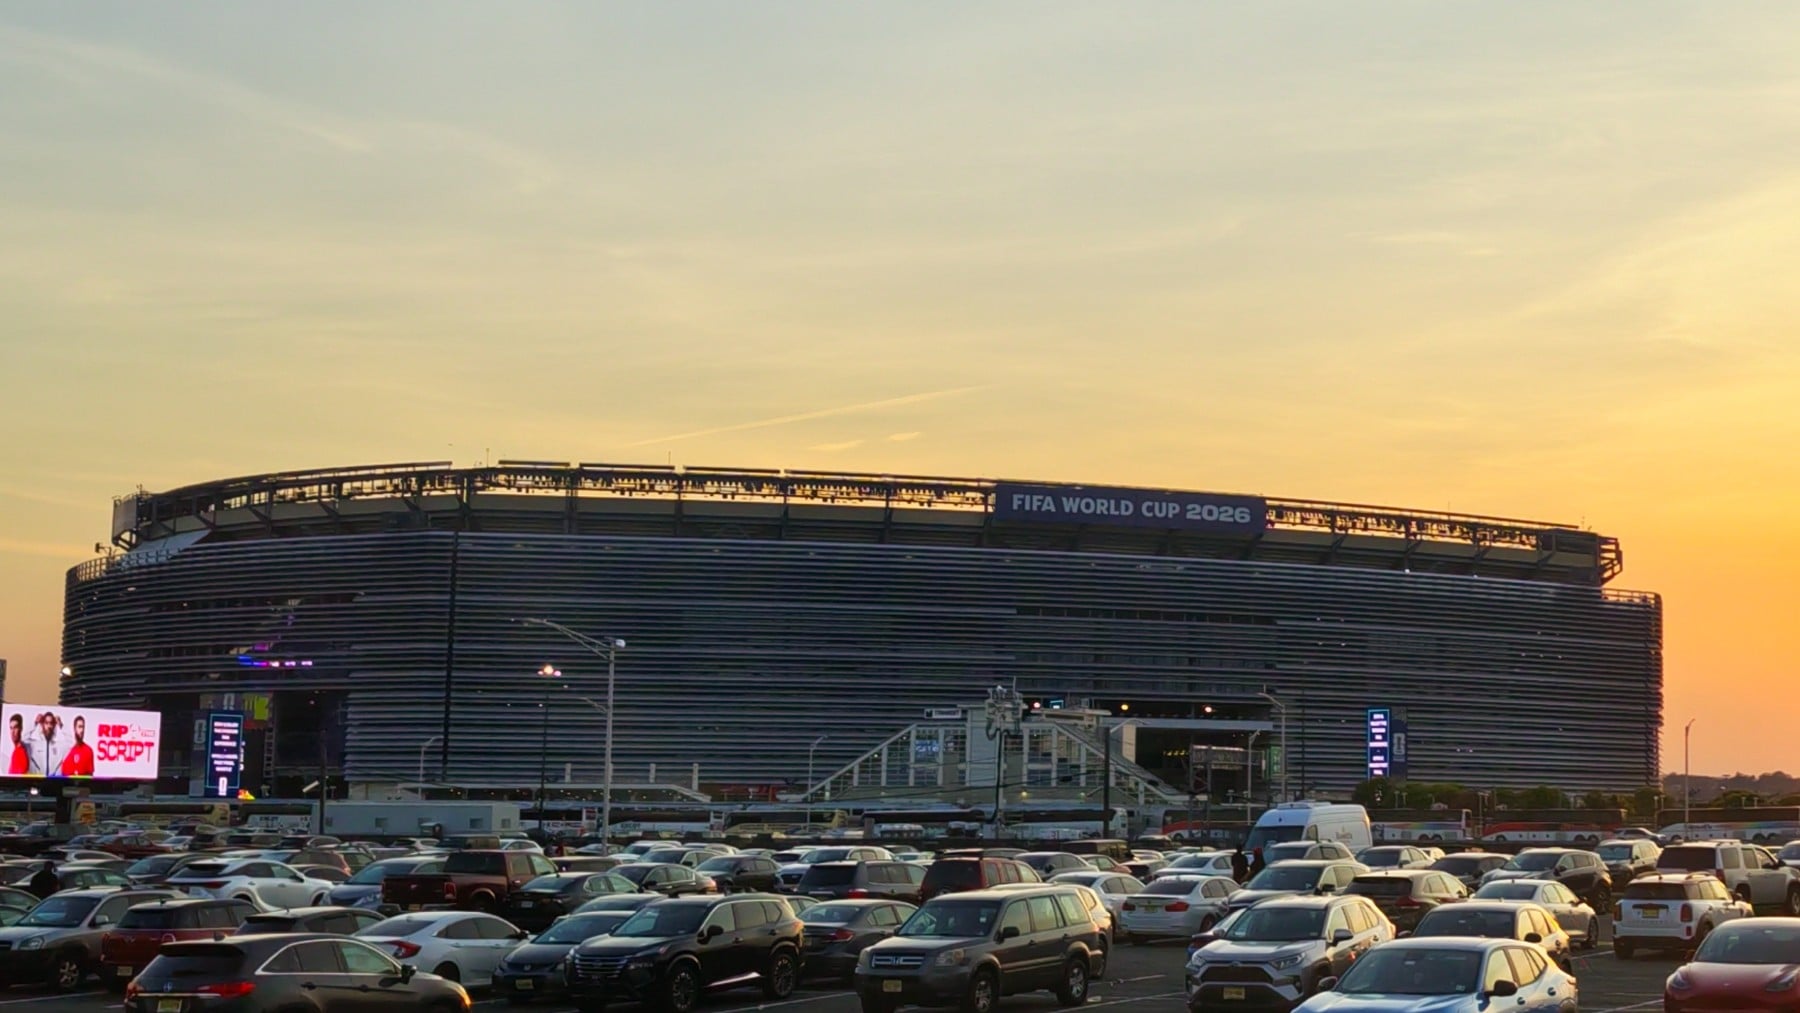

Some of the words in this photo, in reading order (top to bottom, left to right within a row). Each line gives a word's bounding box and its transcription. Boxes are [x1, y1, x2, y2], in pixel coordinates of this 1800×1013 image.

[1012, 493, 1056, 513] FIFA
[1061, 496, 1134, 517] WORLD
[1141, 501, 1180, 519] CUP
[1185, 503, 1251, 523] 2026
[98, 724, 128, 738] RIP
[97, 740, 154, 763] SCRIPT
